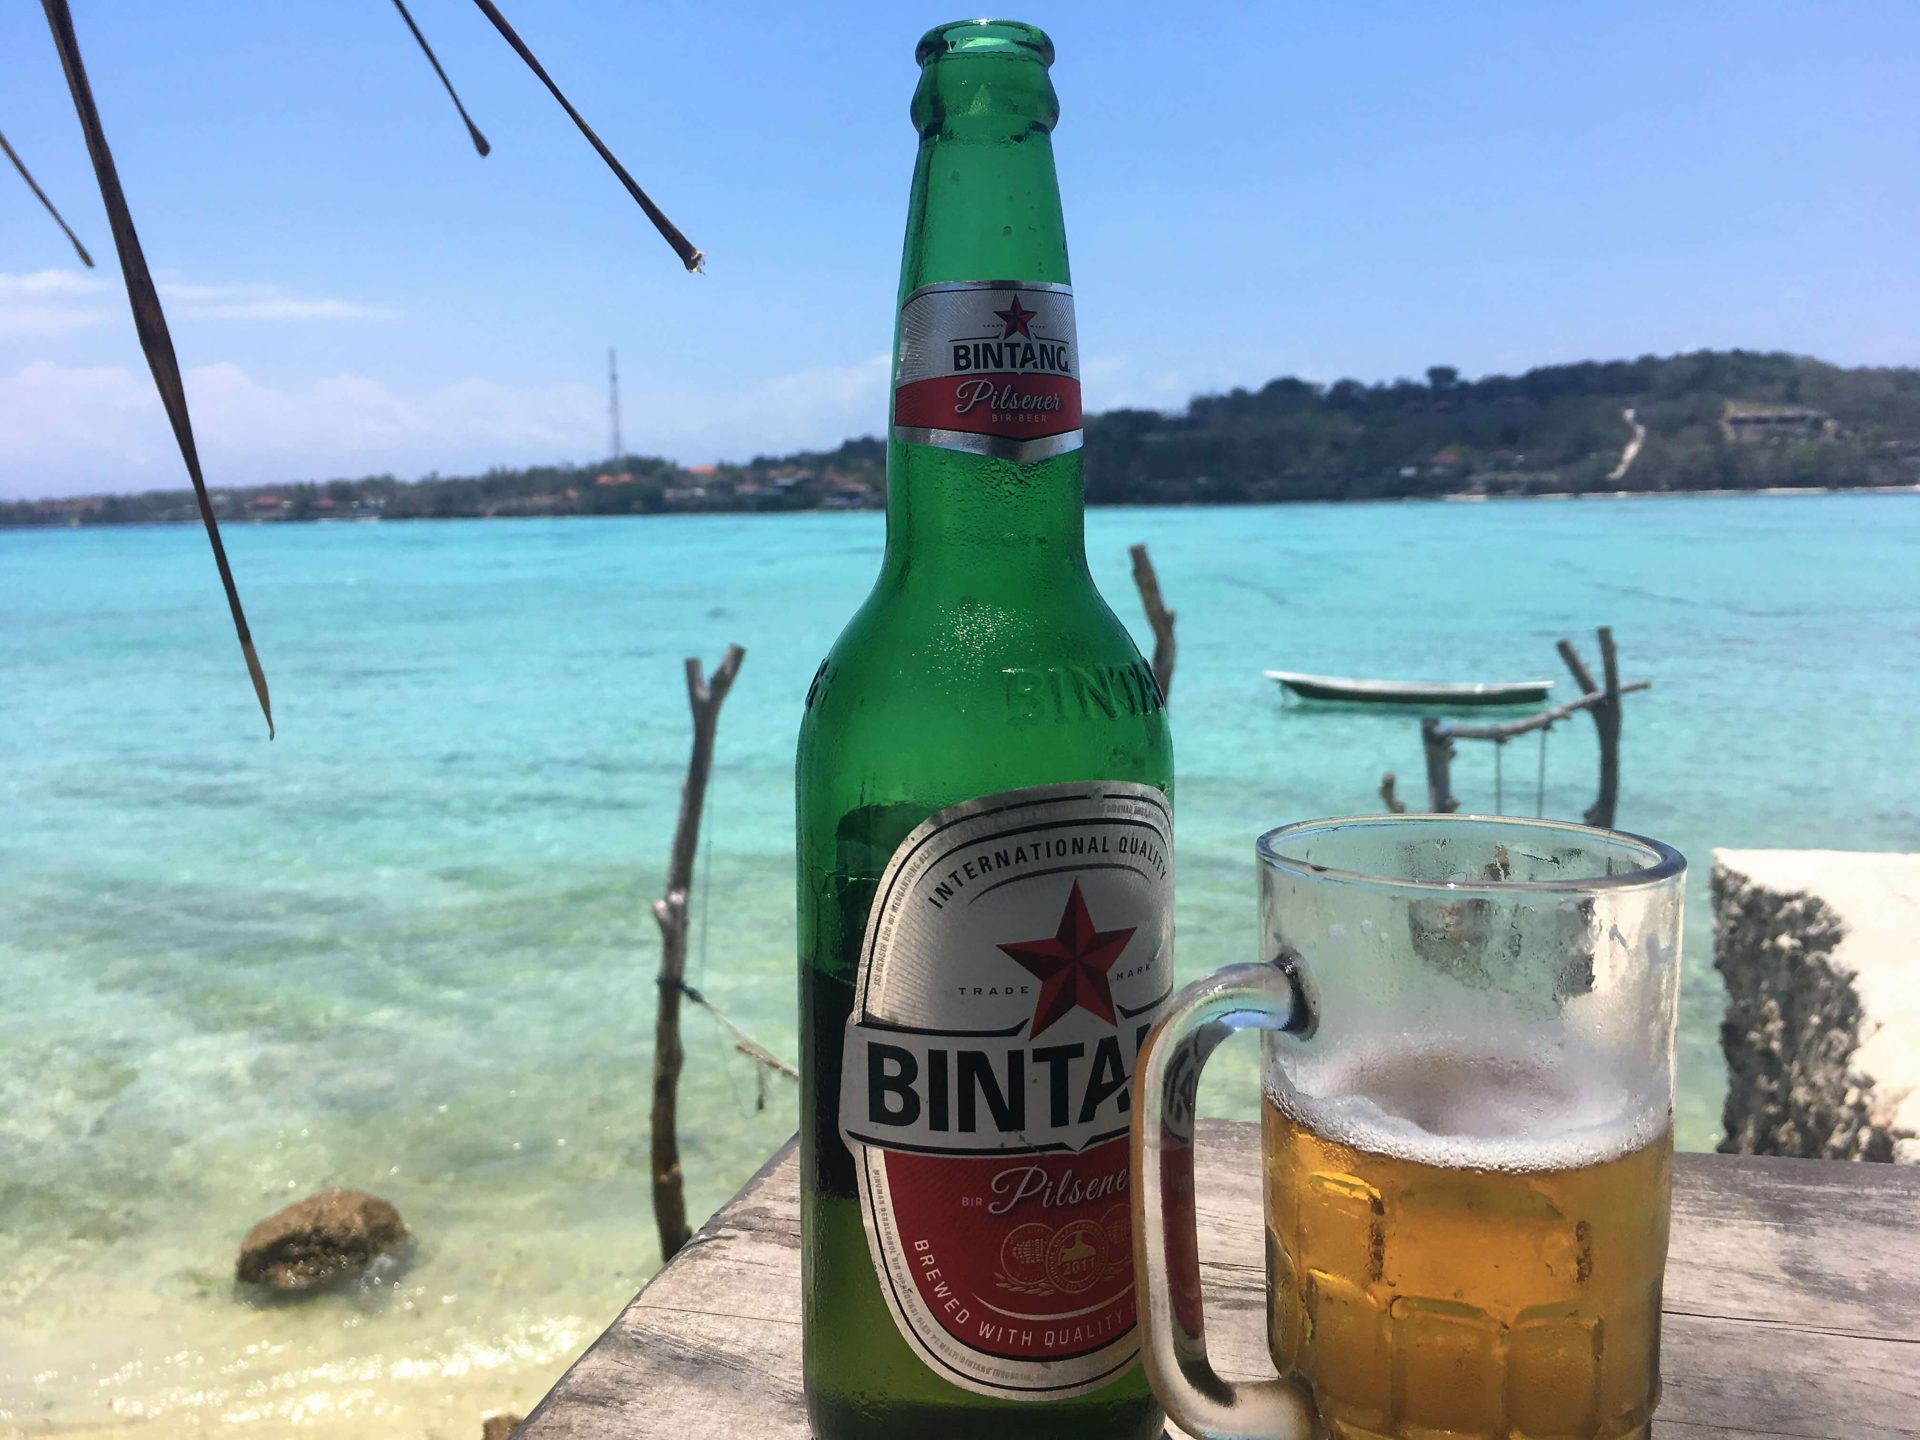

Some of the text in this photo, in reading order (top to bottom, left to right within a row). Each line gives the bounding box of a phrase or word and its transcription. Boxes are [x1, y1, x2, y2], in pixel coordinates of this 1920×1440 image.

[953, 342, 1068, 372] BINTANG
[954, 378, 1061, 413] Pilsener
[928, 835, 1166, 910] INTERNATIONAL QUALITY
[958, 963, 1151, 996] TRADE MARK
[867, 1023, 1151, 1133] BINTA
[961, 1163, 1129, 1214] BIR Pilsene
[1062, 1258, 1096, 1276] 2011
[914, 1239, 1123, 1348] BREWED WITH QUALITY
